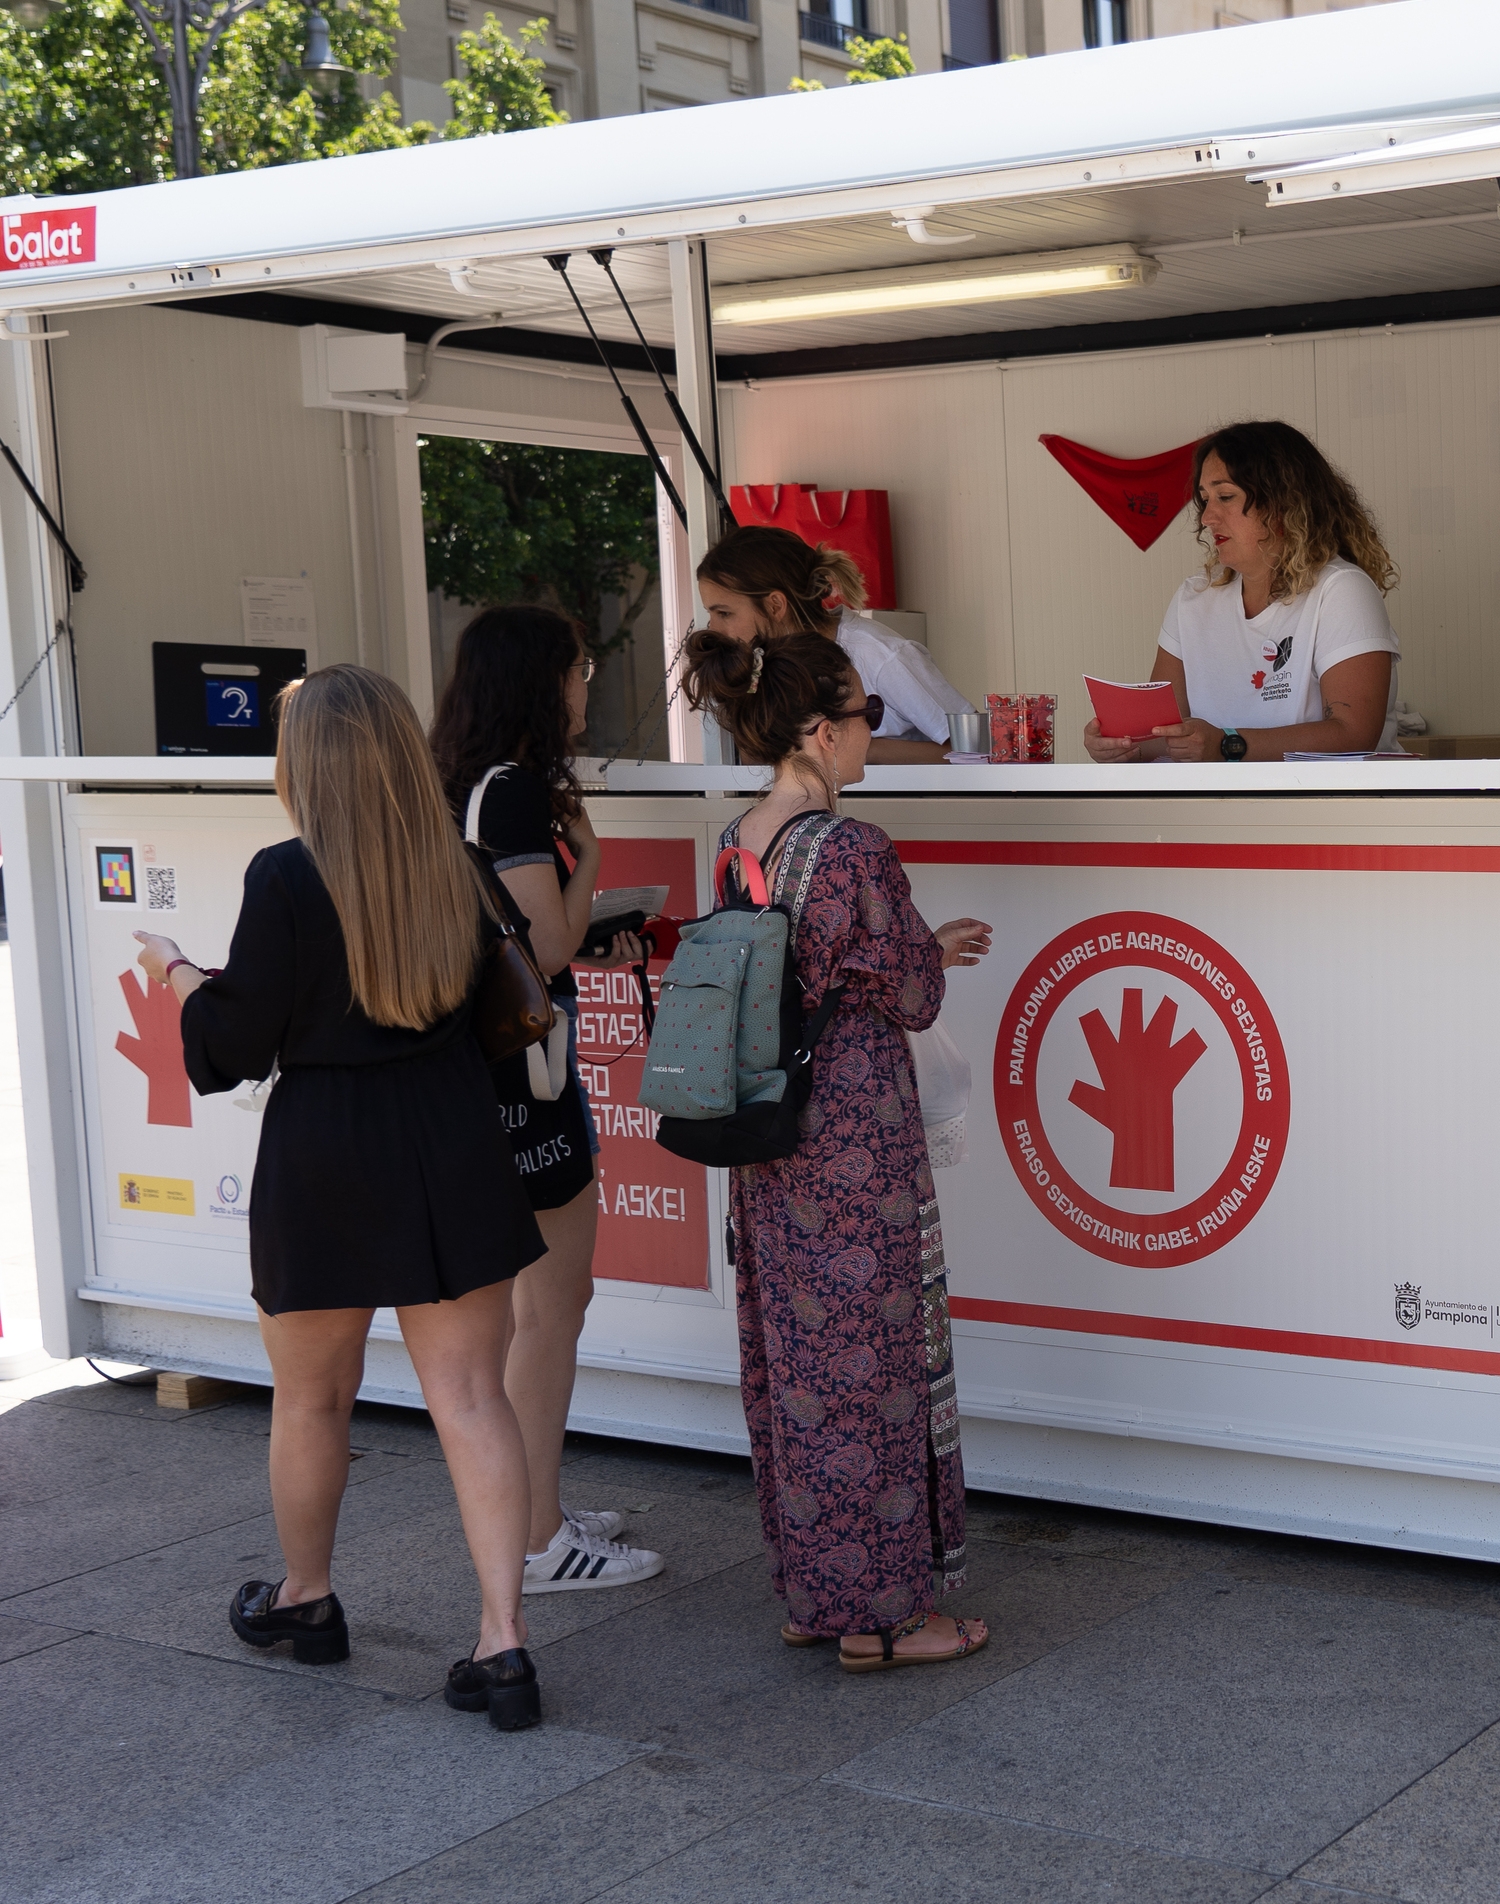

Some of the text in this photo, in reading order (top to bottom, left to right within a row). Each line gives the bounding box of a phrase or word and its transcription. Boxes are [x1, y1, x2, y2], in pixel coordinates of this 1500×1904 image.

[2, 214, 82, 262] balat
[572, 971, 663, 1006] ESIONE
[1010, 931, 1272, 1102] PAMPLONA LIBRE DE AGRESIONES SEXISTAS
[668, 1066, 686, 1074] FAMILY
[515, 1134, 572, 1176] ALISTS
[614, 1183, 686, 1222] ASKE!
[1012, 1119, 1272, 1251] ERASO SEXISTARIK GABE, IRUÑA ASKE
[1425, 1299, 1487, 1312] Ayuntamiento de
[1425, 1309, 1488, 1325] Pamplona
